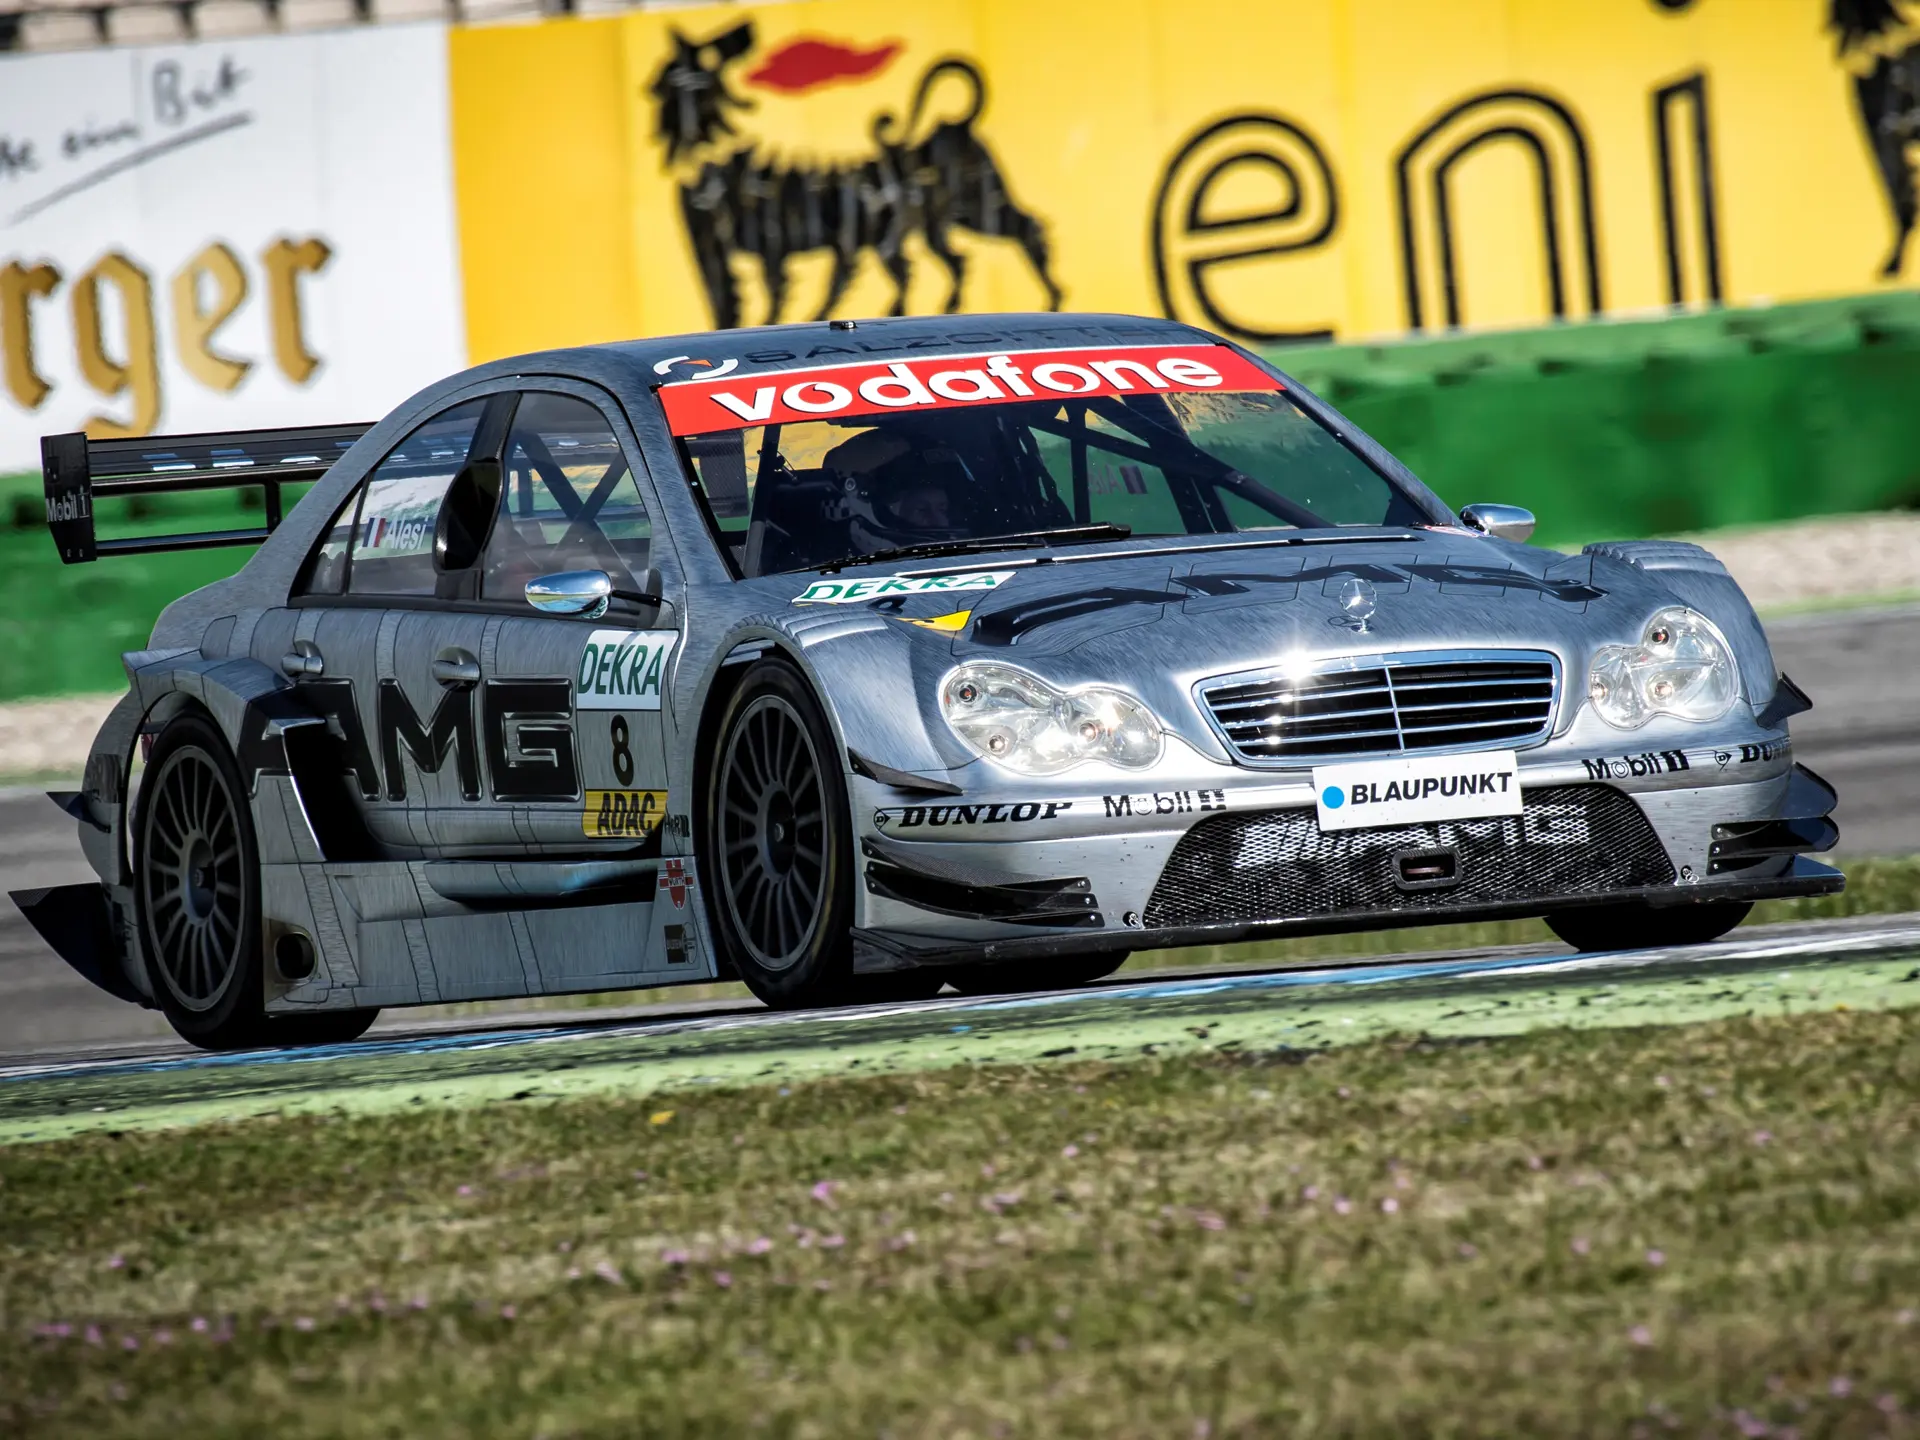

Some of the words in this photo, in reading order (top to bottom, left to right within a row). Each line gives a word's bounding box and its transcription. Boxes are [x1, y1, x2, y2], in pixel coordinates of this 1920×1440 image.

[1149, 0, 1725, 345] eni
[710, 355, 1224, 422] vodafone
[46, 490, 78, 522] Mobil
[384, 514, 429, 550] Alesi
[800, 574, 997, 600] DEKRA
[577, 643, 665, 697] DEKRA
[236, 677, 582, 802] AMG
[610, 714, 634, 787] 8
[1581, 752, 1662, 781] Mobil
[1102, 790, 1193, 818] Mobil
[1350, 772, 1513, 806] BLAUPUNKT
[598, 791, 656, 838] ADAC
[898, 802, 1073, 828] DUNLOP
